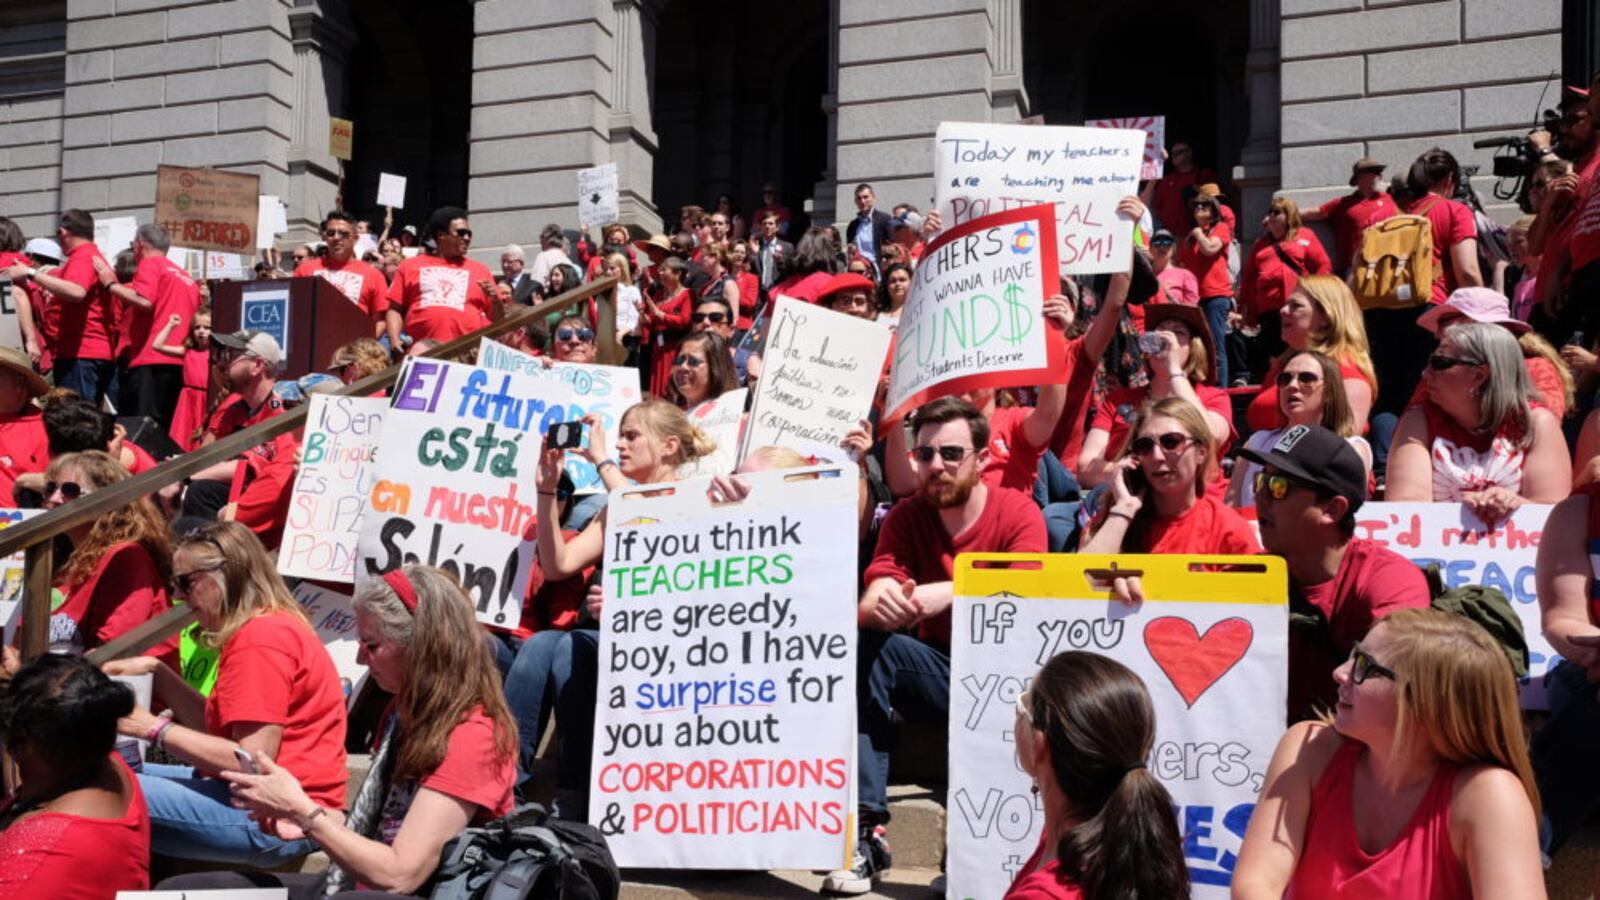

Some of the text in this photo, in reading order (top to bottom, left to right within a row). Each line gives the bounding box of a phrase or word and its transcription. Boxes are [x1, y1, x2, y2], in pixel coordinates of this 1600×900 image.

[941, 138, 1130, 165] Today my teachers
[951, 173, 1135, 192] are teaching me about
[935, 273, 983, 303] WANNA
[993, 261, 1034, 285] HAVE
[247, 304, 281, 323] CEA
[897, 283, 1033, 367] FUND$
[925, 353, 973, 382] Students
[977, 350, 1024, 369] Deserve
[418, 424, 522, 478] está
[296, 467, 328, 494] Es
[371, 479, 413, 515] en
[613, 516, 802, 564] If you think
[609, 553, 794, 599] TEACHERS
[612, 593, 798, 638] are greedy,
[970, 601, 1125, 667] If you
[610, 631, 848, 677] boy, do I have
[609, 667, 843, 714] a surprise for
[603, 714, 780, 757] you about
[599, 758, 846, 793] CORPORATIONS
[600, 801, 843, 836] & POLITICIANS
